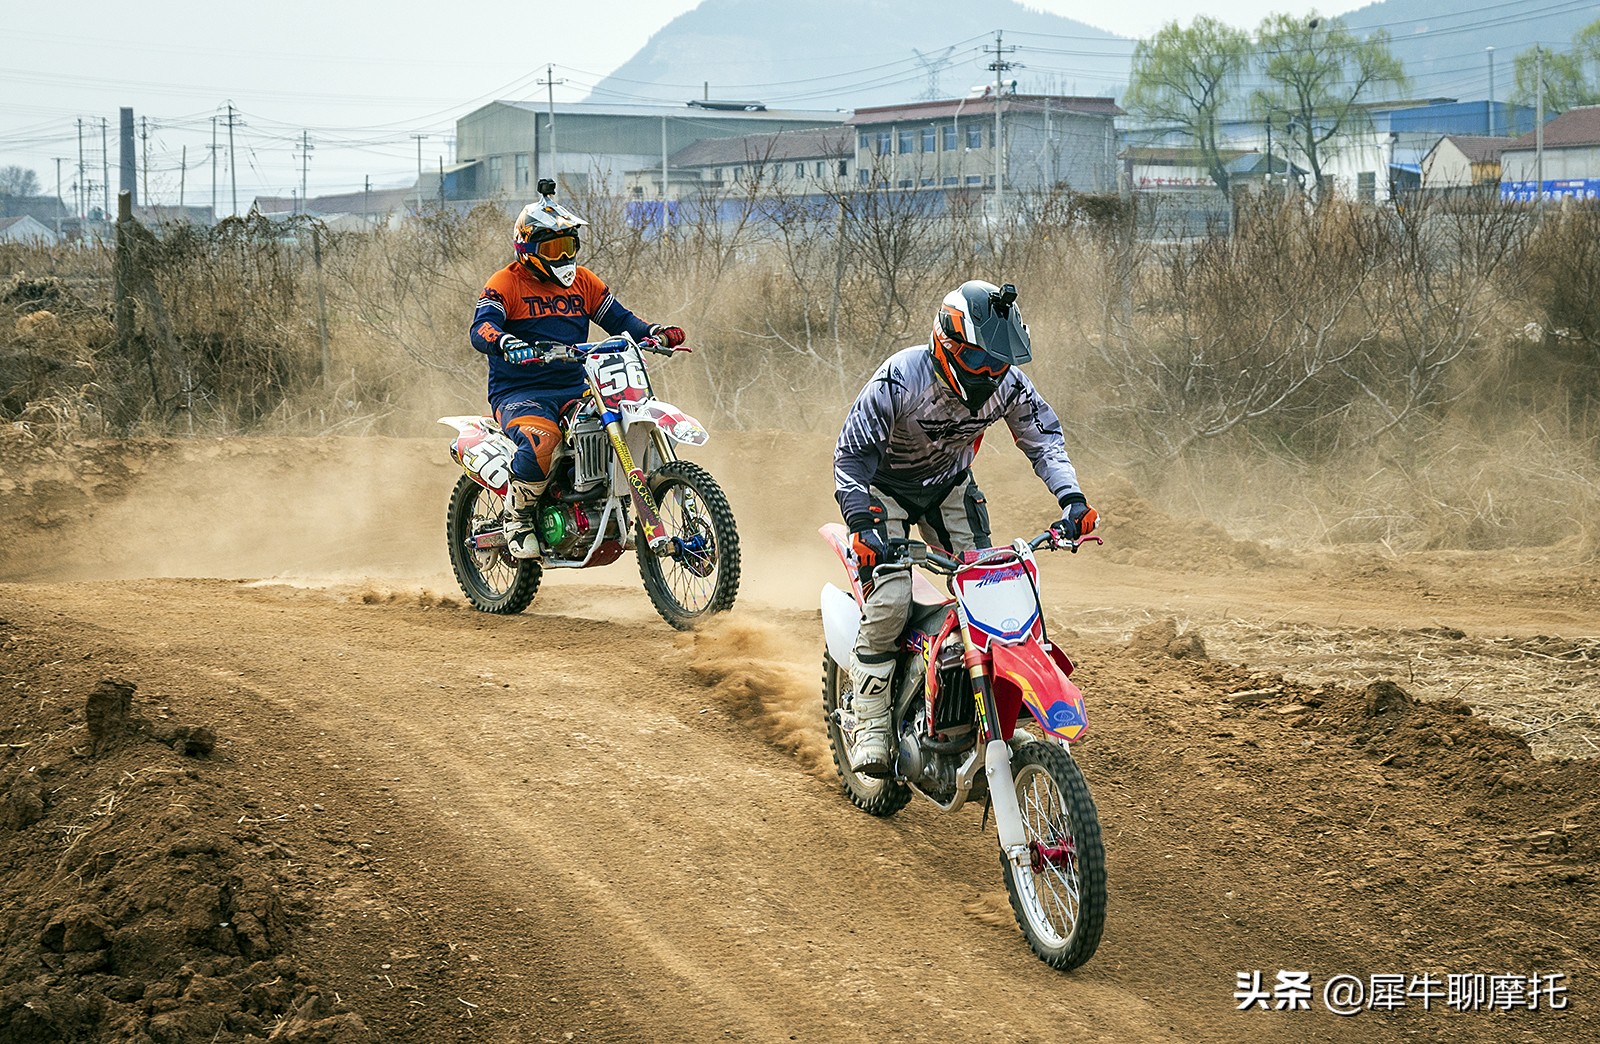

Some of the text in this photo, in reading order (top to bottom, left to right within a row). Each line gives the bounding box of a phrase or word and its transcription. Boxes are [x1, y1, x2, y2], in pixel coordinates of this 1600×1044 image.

[521, 294, 590, 317] THOR
[598, 361, 649, 397] 56
[524, 425, 551, 438] thor
[462, 440, 509, 489] 56
[543, 514, 555, 529] 56
